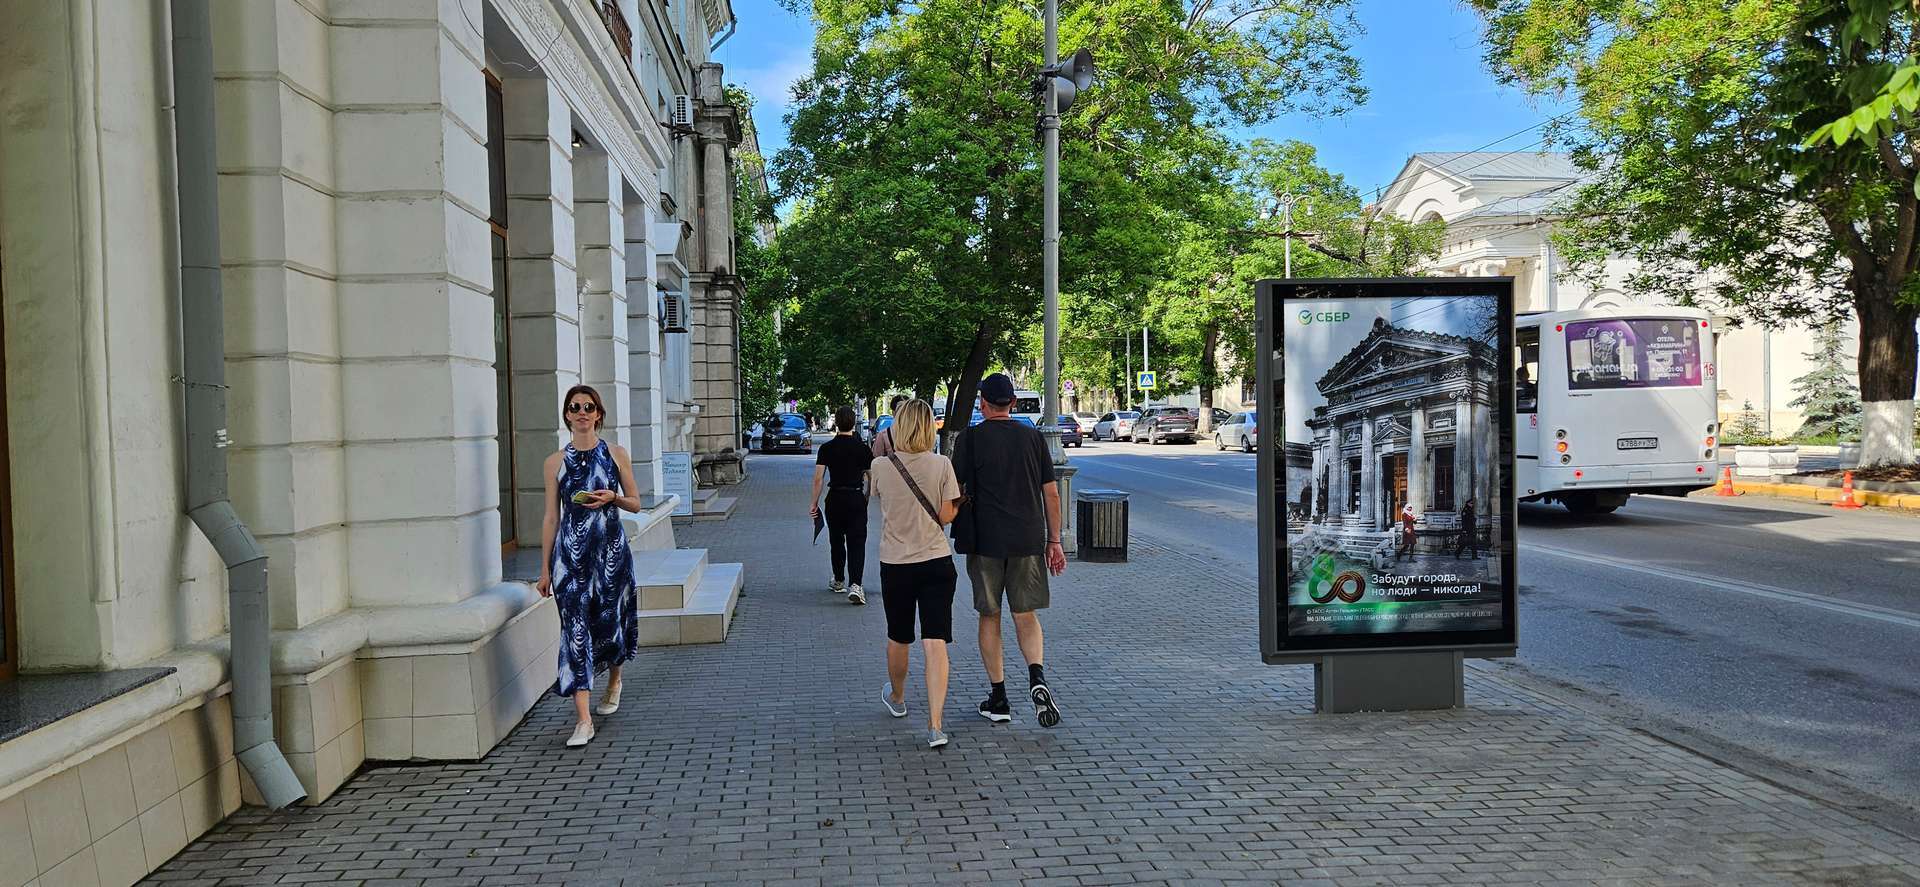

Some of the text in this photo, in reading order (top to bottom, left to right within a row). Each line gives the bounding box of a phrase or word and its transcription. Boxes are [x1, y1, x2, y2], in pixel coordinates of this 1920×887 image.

[1316, 312, 1350, 322] СБЕР
[1703, 362, 1715, 377] 16
[1529, 413, 1537, 428] 16
[1371, 573, 1460, 585] Забудут города,
[1371, 588, 1385, 596] но
[1387, 587, 1417, 597] люди
[1433, 582, 1481, 594] никогда!
